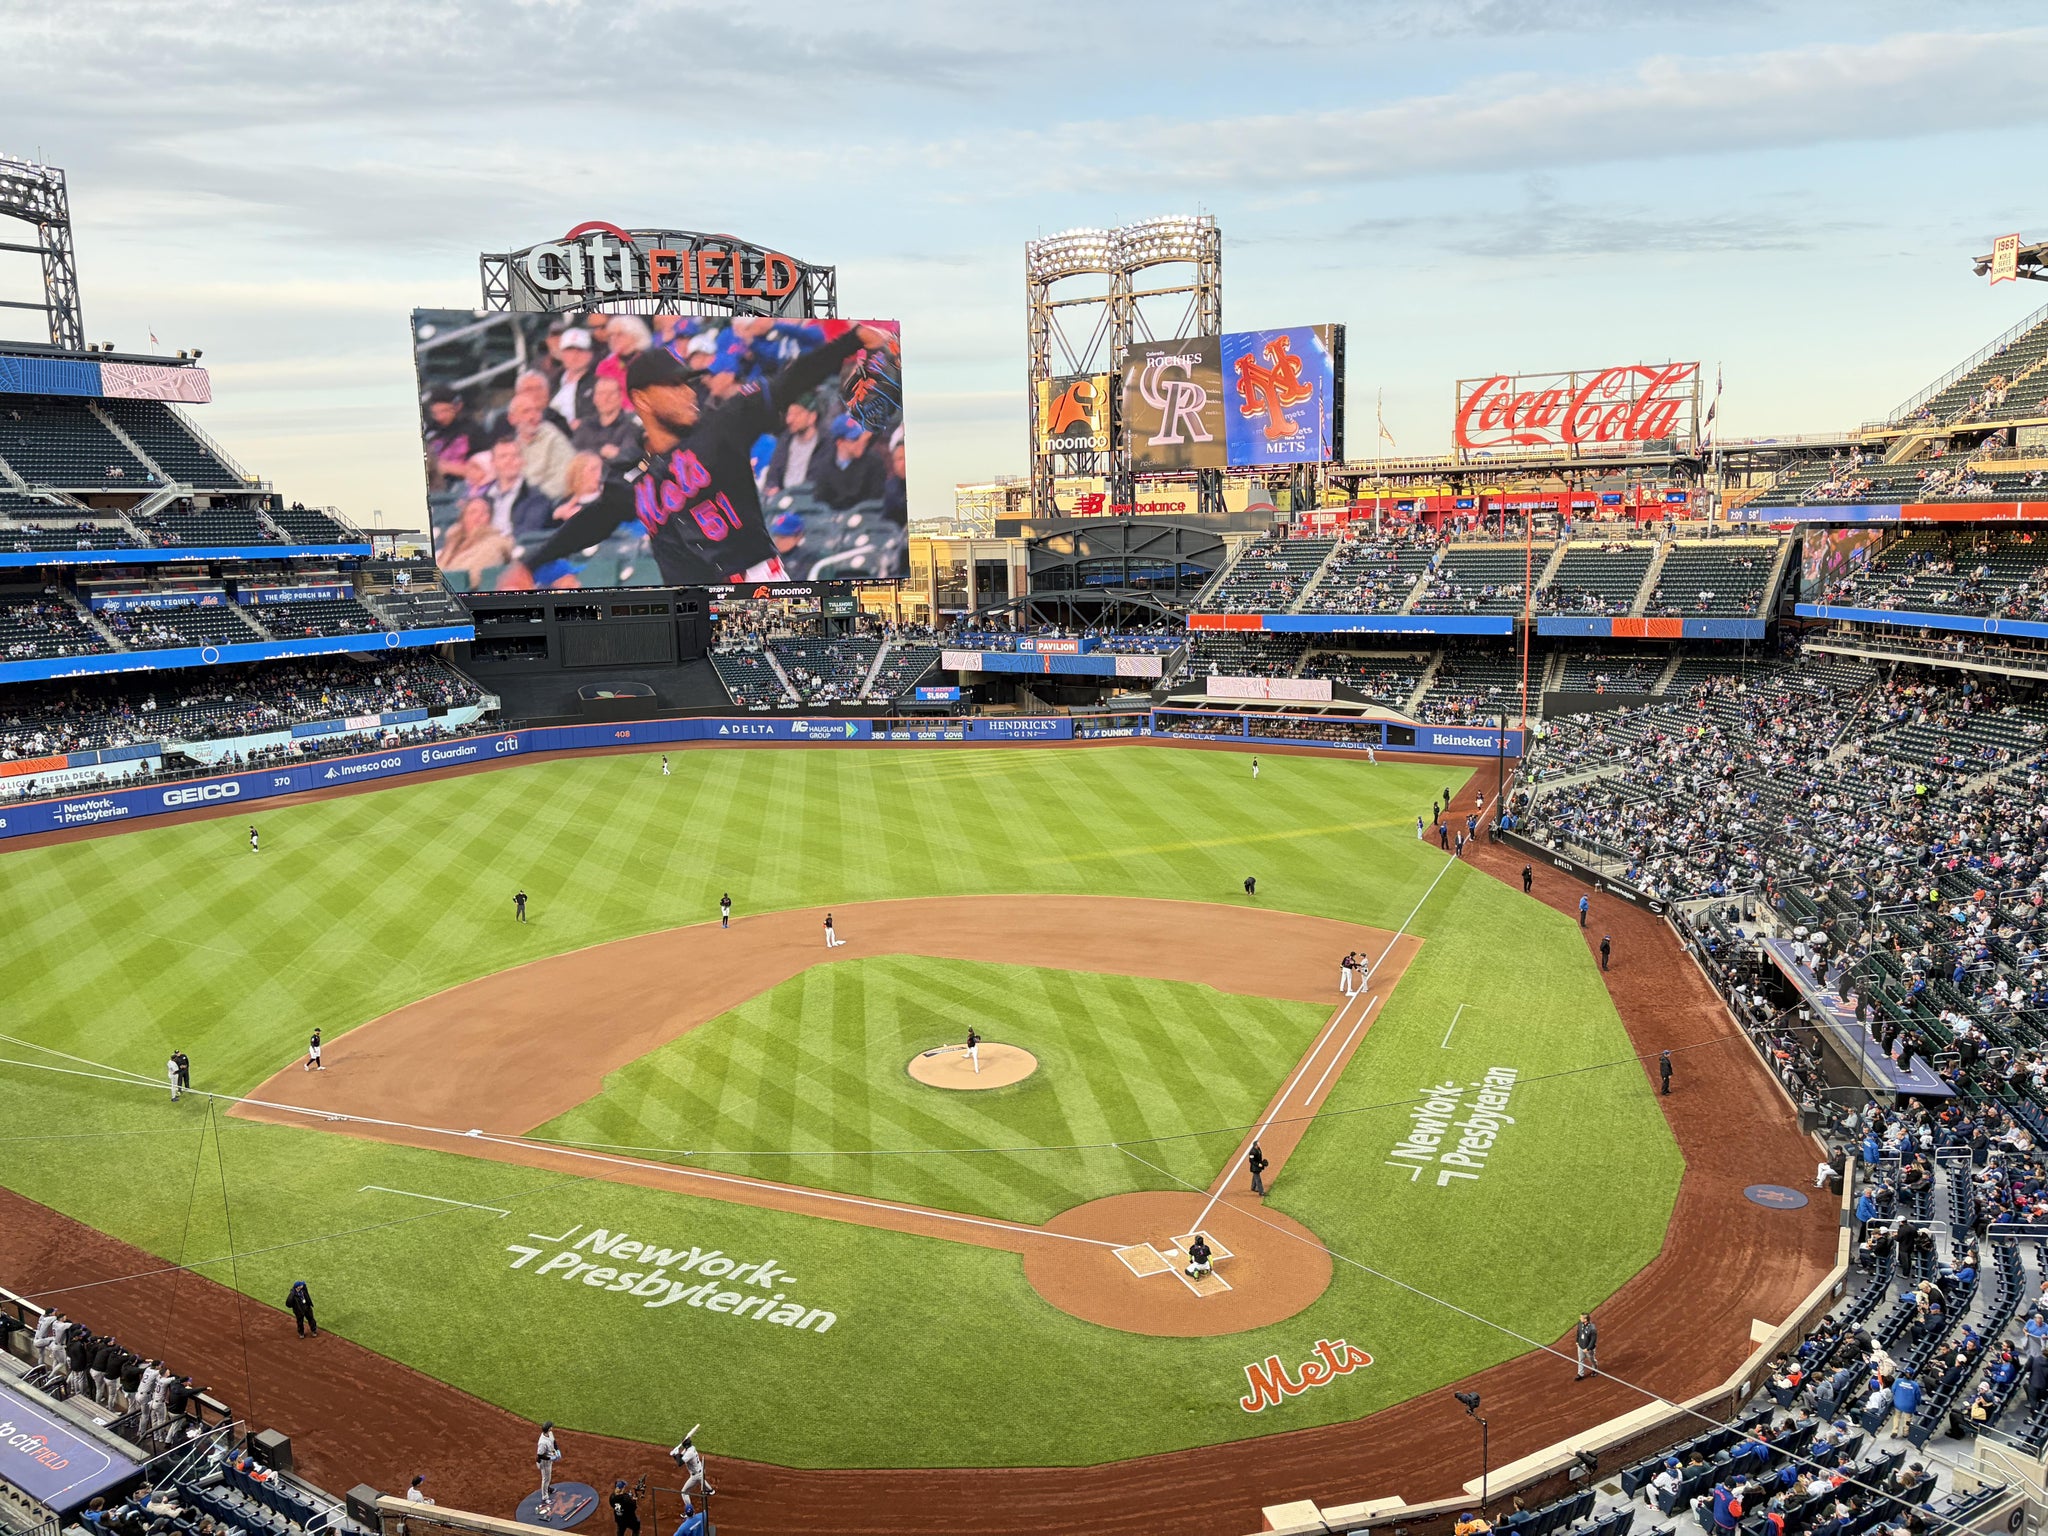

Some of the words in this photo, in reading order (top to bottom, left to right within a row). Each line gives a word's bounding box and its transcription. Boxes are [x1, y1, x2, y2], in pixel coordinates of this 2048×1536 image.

[1997, 239, 2015, 252] 1969
[527, 235, 632, 292] citi
[647, 248, 798, 296] FIELD
[1146, 352, 1202, 368] ROCKIES
[1044, 435, 1108, 451] moomoo
[1266, 441, 1306, 454] METS
[1108, 503, 1133, 514] new
[1135, 500, 1186, 513] balance
[689, 490, 743, 541] 51
[1730, 511, 1743, 519] 7:09
[264, 593, 278, 601] THE
[293, 592, 316, 600] PORCH
[318, 591, 331, 599] BAR
[771, 587, 812, 596] moomoo
[1038, 642, 1075, 651] PAVILION
[926, 692, 949, 700] $1,500
[732, 724, 774, 734] DELTA
[989, 720, 1057, 730] HENDRICK'S
[615, 730, 631, 738] 408
[871, 732, 885, 740] 380
[891, 731, 911, 739] GOYA
[917, 731, 937, 739] GOYA
[943, 731, 963, 739] GOYA
[1101, 728, 1134, 737] DUNKIN'
[1140, 728, 1152, 736] 370
[1172, 732, 1216, 741] CADILLAC
[495, 738, 518, 752] citi
[1333, 741, 1384, 750] CADILLAC
[1431, 733, 1491, 748] Heineken
[431, 746, 477, 761] Guardian
[340, 762, 379, 777] Invesco
[380, 757, 402, 770] QQQ
[41, 773, 70, 785] FIESTA
[72, 770, 97, 780] DECK
[273, 776, 290, 787] 370
[162, 781, 240, 807] GEICO
[63, 798, 114, 814] NewYork-
[65, 805, 129, 823] Presbyterian
[1390, 1080, 1464, 1161] NewYork-
[1440, 1066, 1518, 1169] Presbyterian
[572, 1228, 798, 1288] NewYork-
[535, 1251, 837, 1333] Presbyterian
[1240, 1339, 1374, 1413] Mets
[29, 1445, 70, 1471] FIELD
